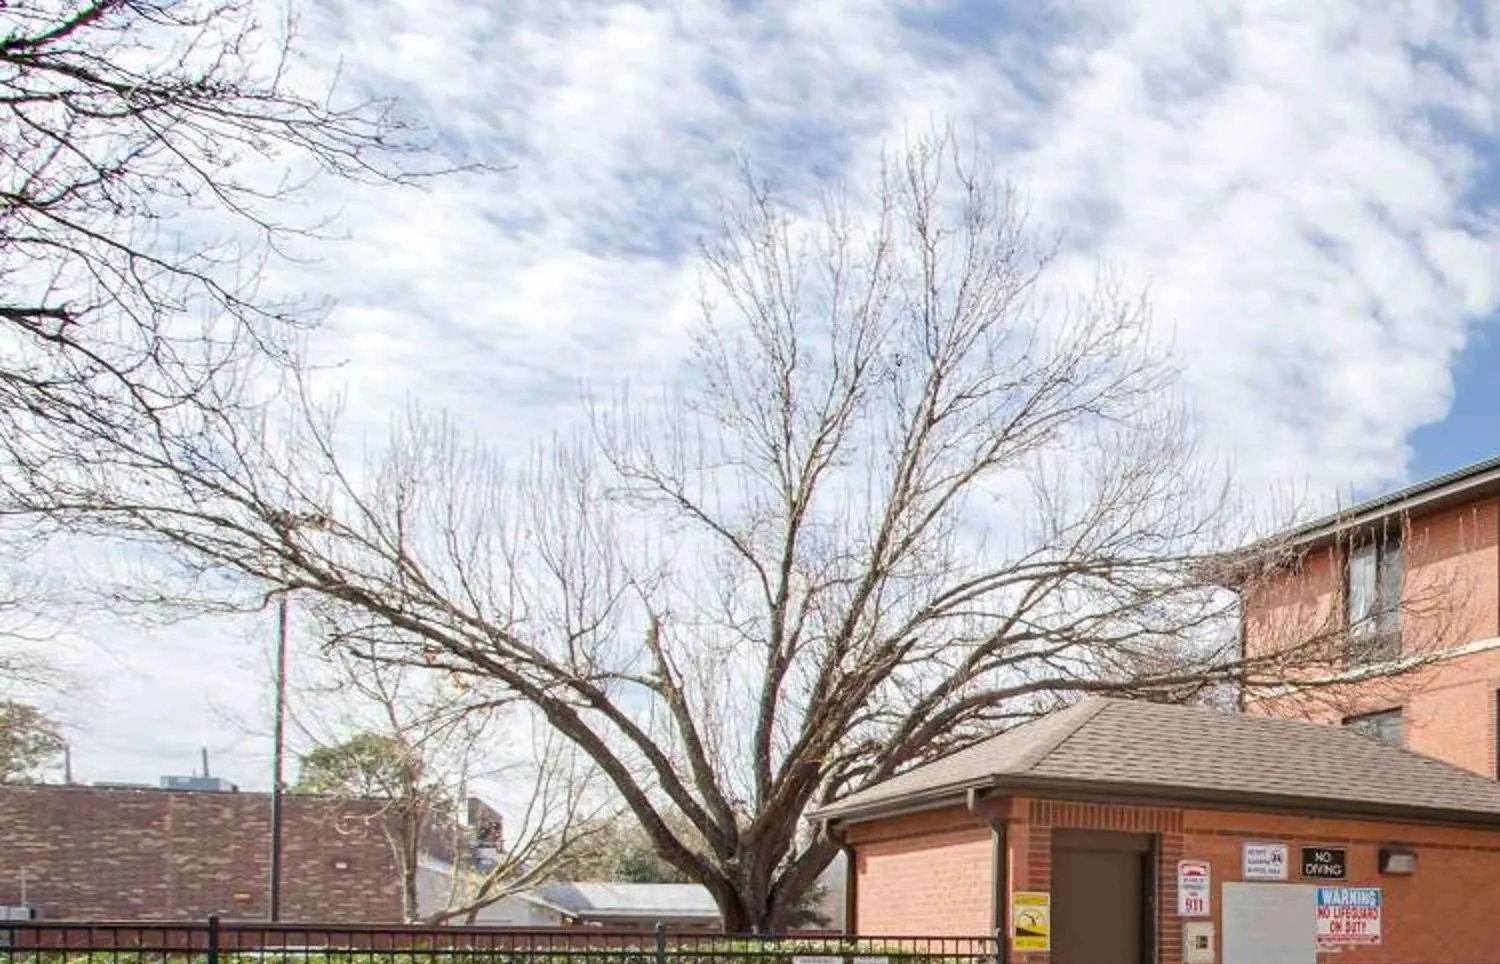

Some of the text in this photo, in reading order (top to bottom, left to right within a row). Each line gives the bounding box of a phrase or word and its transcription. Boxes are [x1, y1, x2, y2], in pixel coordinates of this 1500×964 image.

[1315, 852, 1333, 863] NO
[1305, 863, 1342, 875] DIVING
[1321, 888, 1377, 906] WARNING
[1185, 898, 1203, 913] 911
[1317, 907, 1379, 920] NO LIFEGUARD
[1329, 921, 1367, 933] ON DUTY
